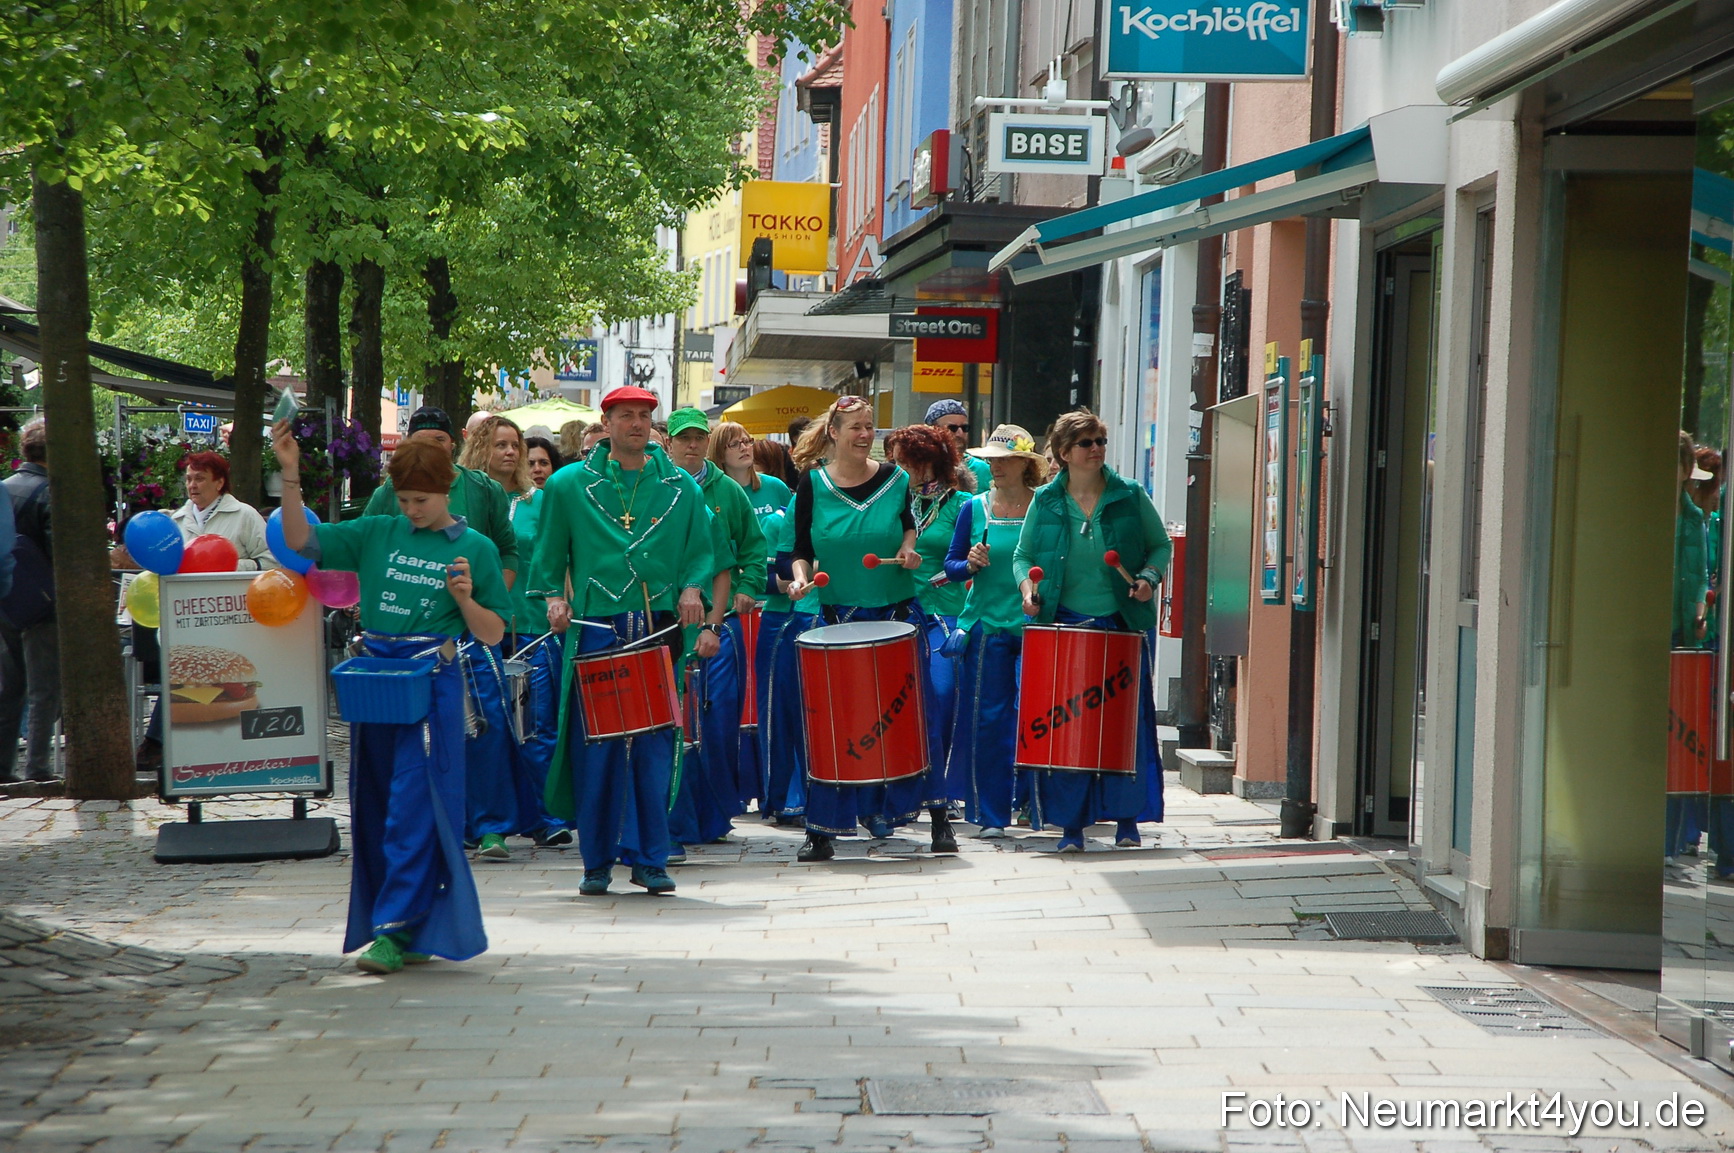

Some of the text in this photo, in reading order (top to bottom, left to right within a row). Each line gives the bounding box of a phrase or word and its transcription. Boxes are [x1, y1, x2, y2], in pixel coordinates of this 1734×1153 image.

[1119, 1, 1300, 41] Kochlöffel
[1011, 132, 1083, 156] BASE
[895, 319, 981, 335] Street One
[685, 350, 714, 360] TAIFU
[920, 367, 956, 377] DHL
[186, 416, 211, 430] TAXI
[396, 553, 449, 574] sarar
[386, 567, 446, 590] Fanshop
[174, 594, 248, 616] CHEESEBU
[381, 591, 397, 602] CD
[379, 602, 412, 616] Button
[176, 612, 257, 629] MIT ZARTSCHMELZE
[1030, 660, 1135, 741] sarará
[859, 672, 918, 751] sarará
[175, 757, 293, 783] So geht lecker!
